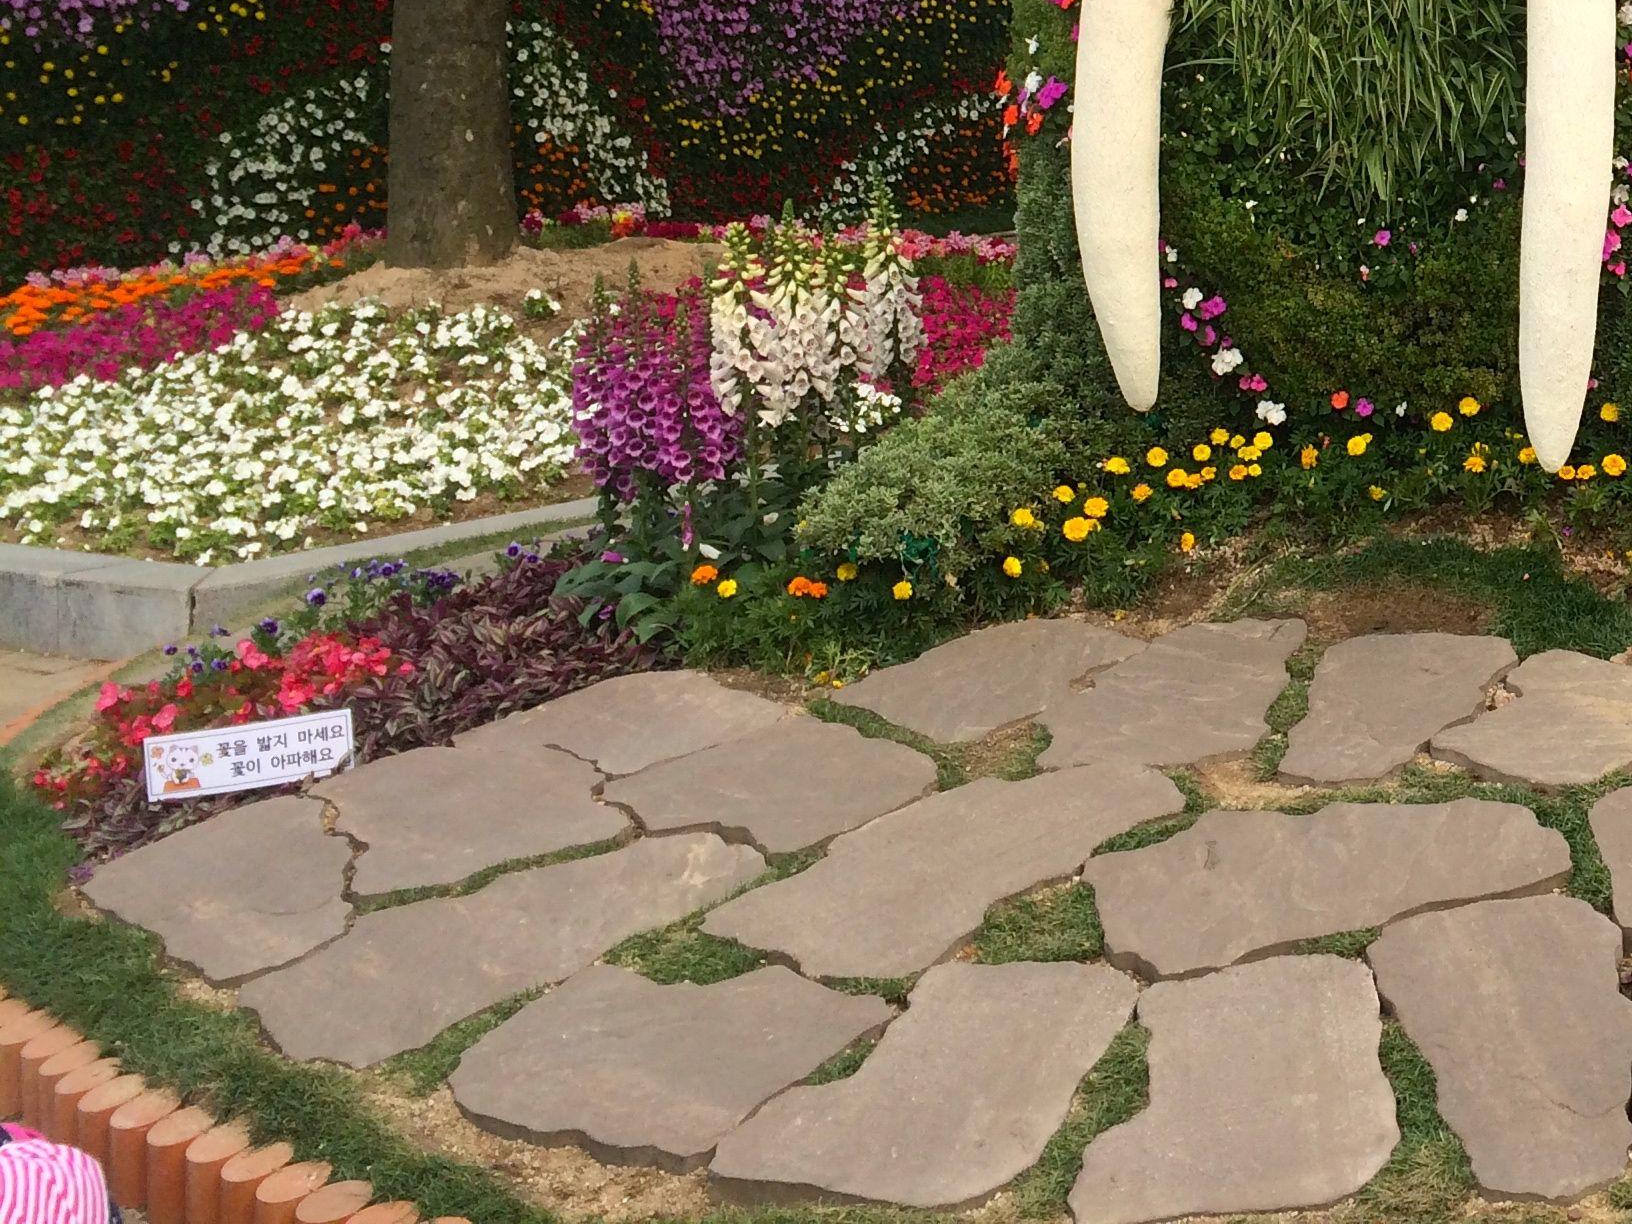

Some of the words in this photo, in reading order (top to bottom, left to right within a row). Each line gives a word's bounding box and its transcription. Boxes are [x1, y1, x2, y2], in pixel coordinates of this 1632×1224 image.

[216, 739, 248, 759] 꽃을
[256, 733, 288, 752] 밟지
[297, 723, 345, 744] 마세요
[230, 757, 262, 778] 꽃이
[270, 747, 335, 770] 아파해요
